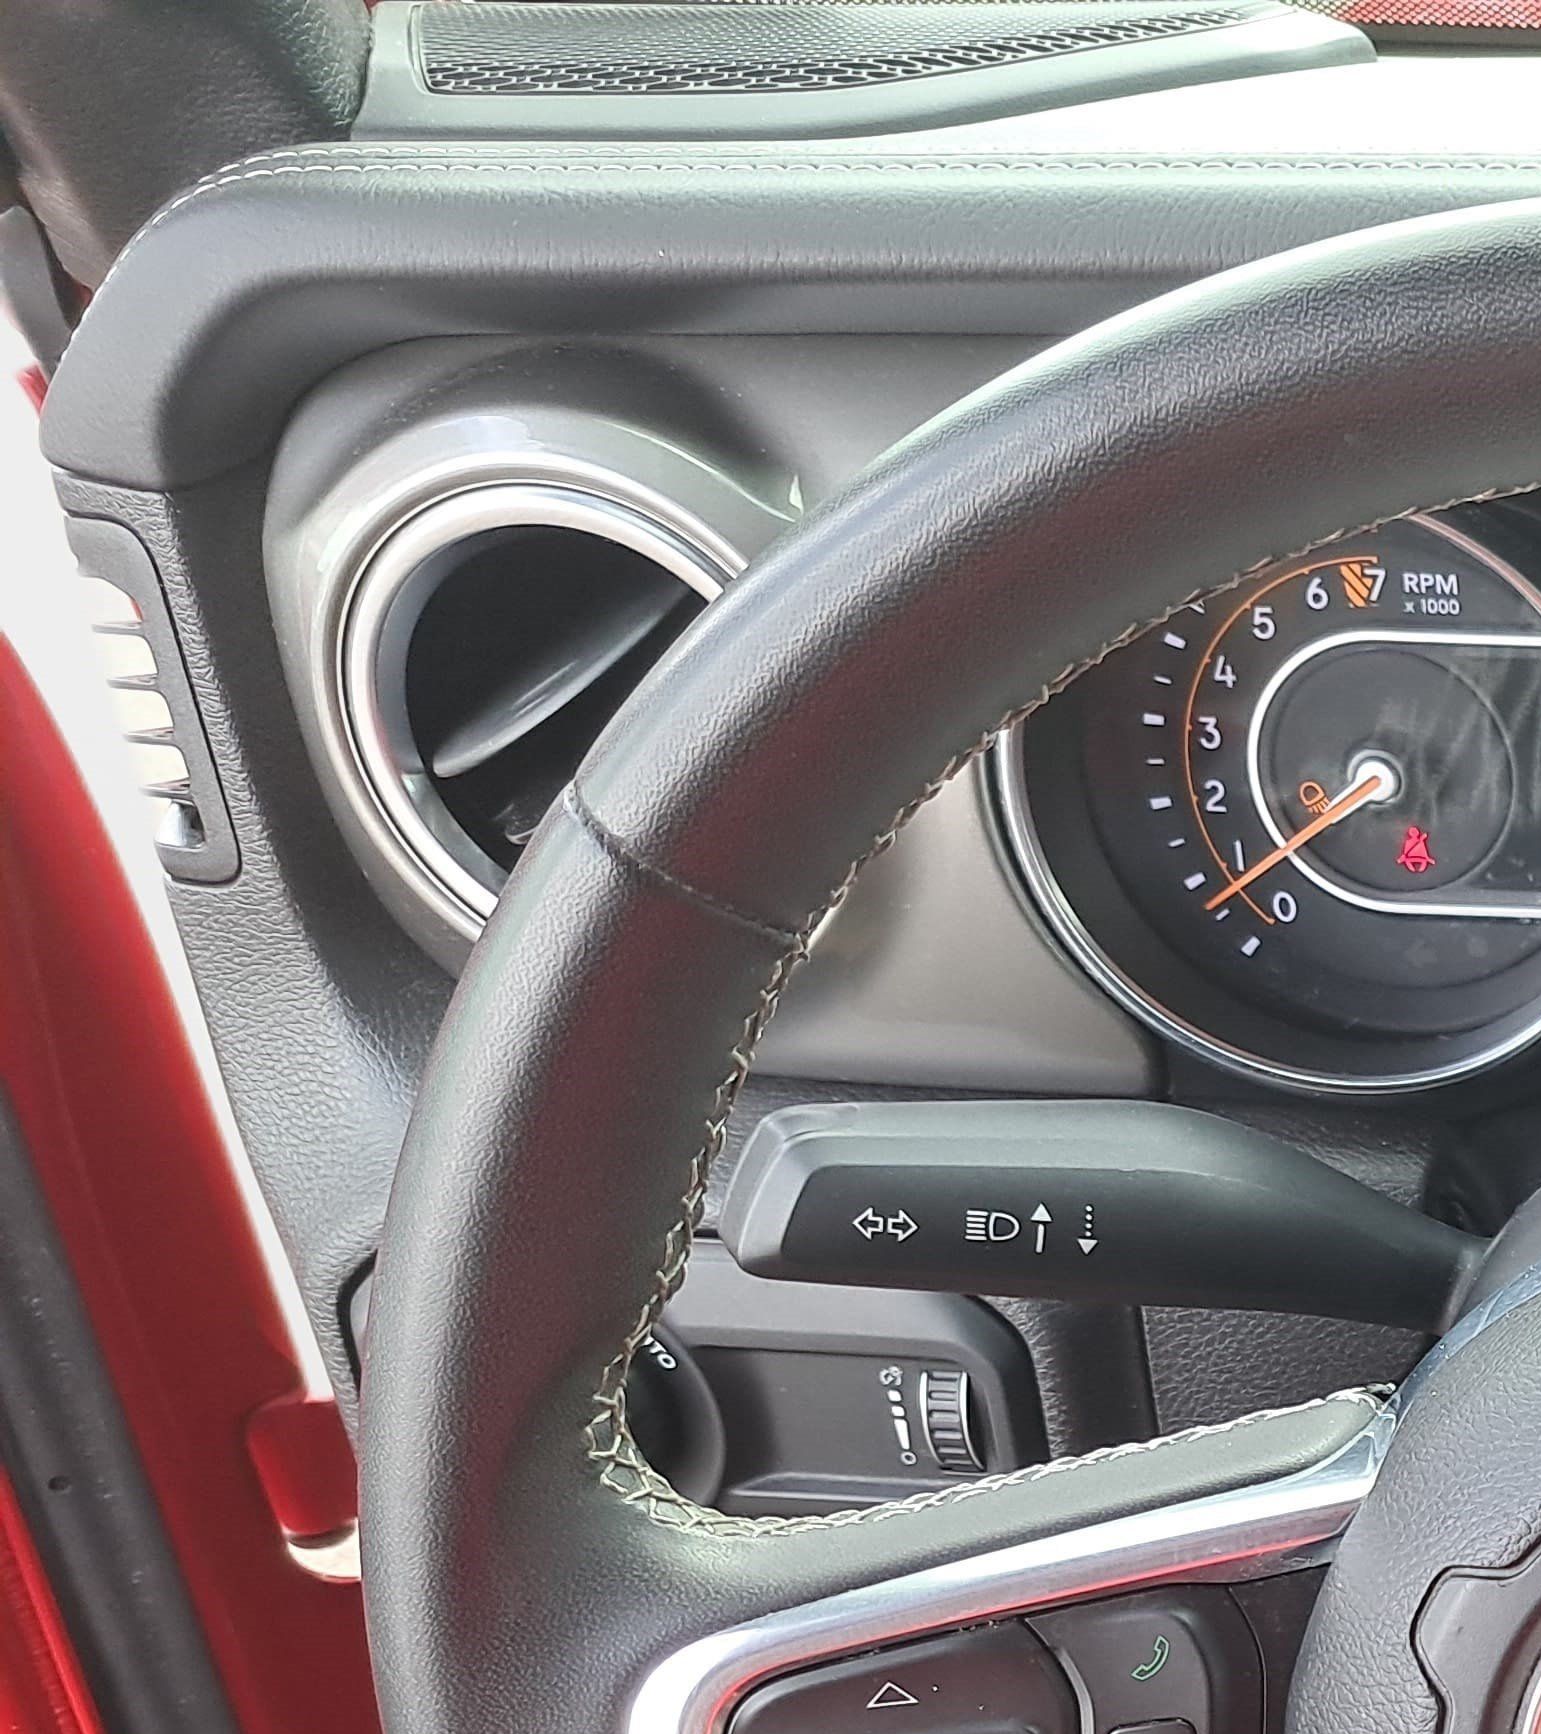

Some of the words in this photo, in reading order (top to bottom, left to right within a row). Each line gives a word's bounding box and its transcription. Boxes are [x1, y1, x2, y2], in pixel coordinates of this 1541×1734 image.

[1306, 579, 1329, 610] 6
[1365, 567, 1388, 602] 7
[1402, 572, 1458, 596] RPM
[1251, 606, 1276, 640] 5
[1420, 598, 1460, 615] 1000
[1213, 655, 1237, 689] 4
[1198, 716, 1221, 750] 3
[1204, 779, 1227, 813] 2
[1271, 891, 1298, 924] 0
